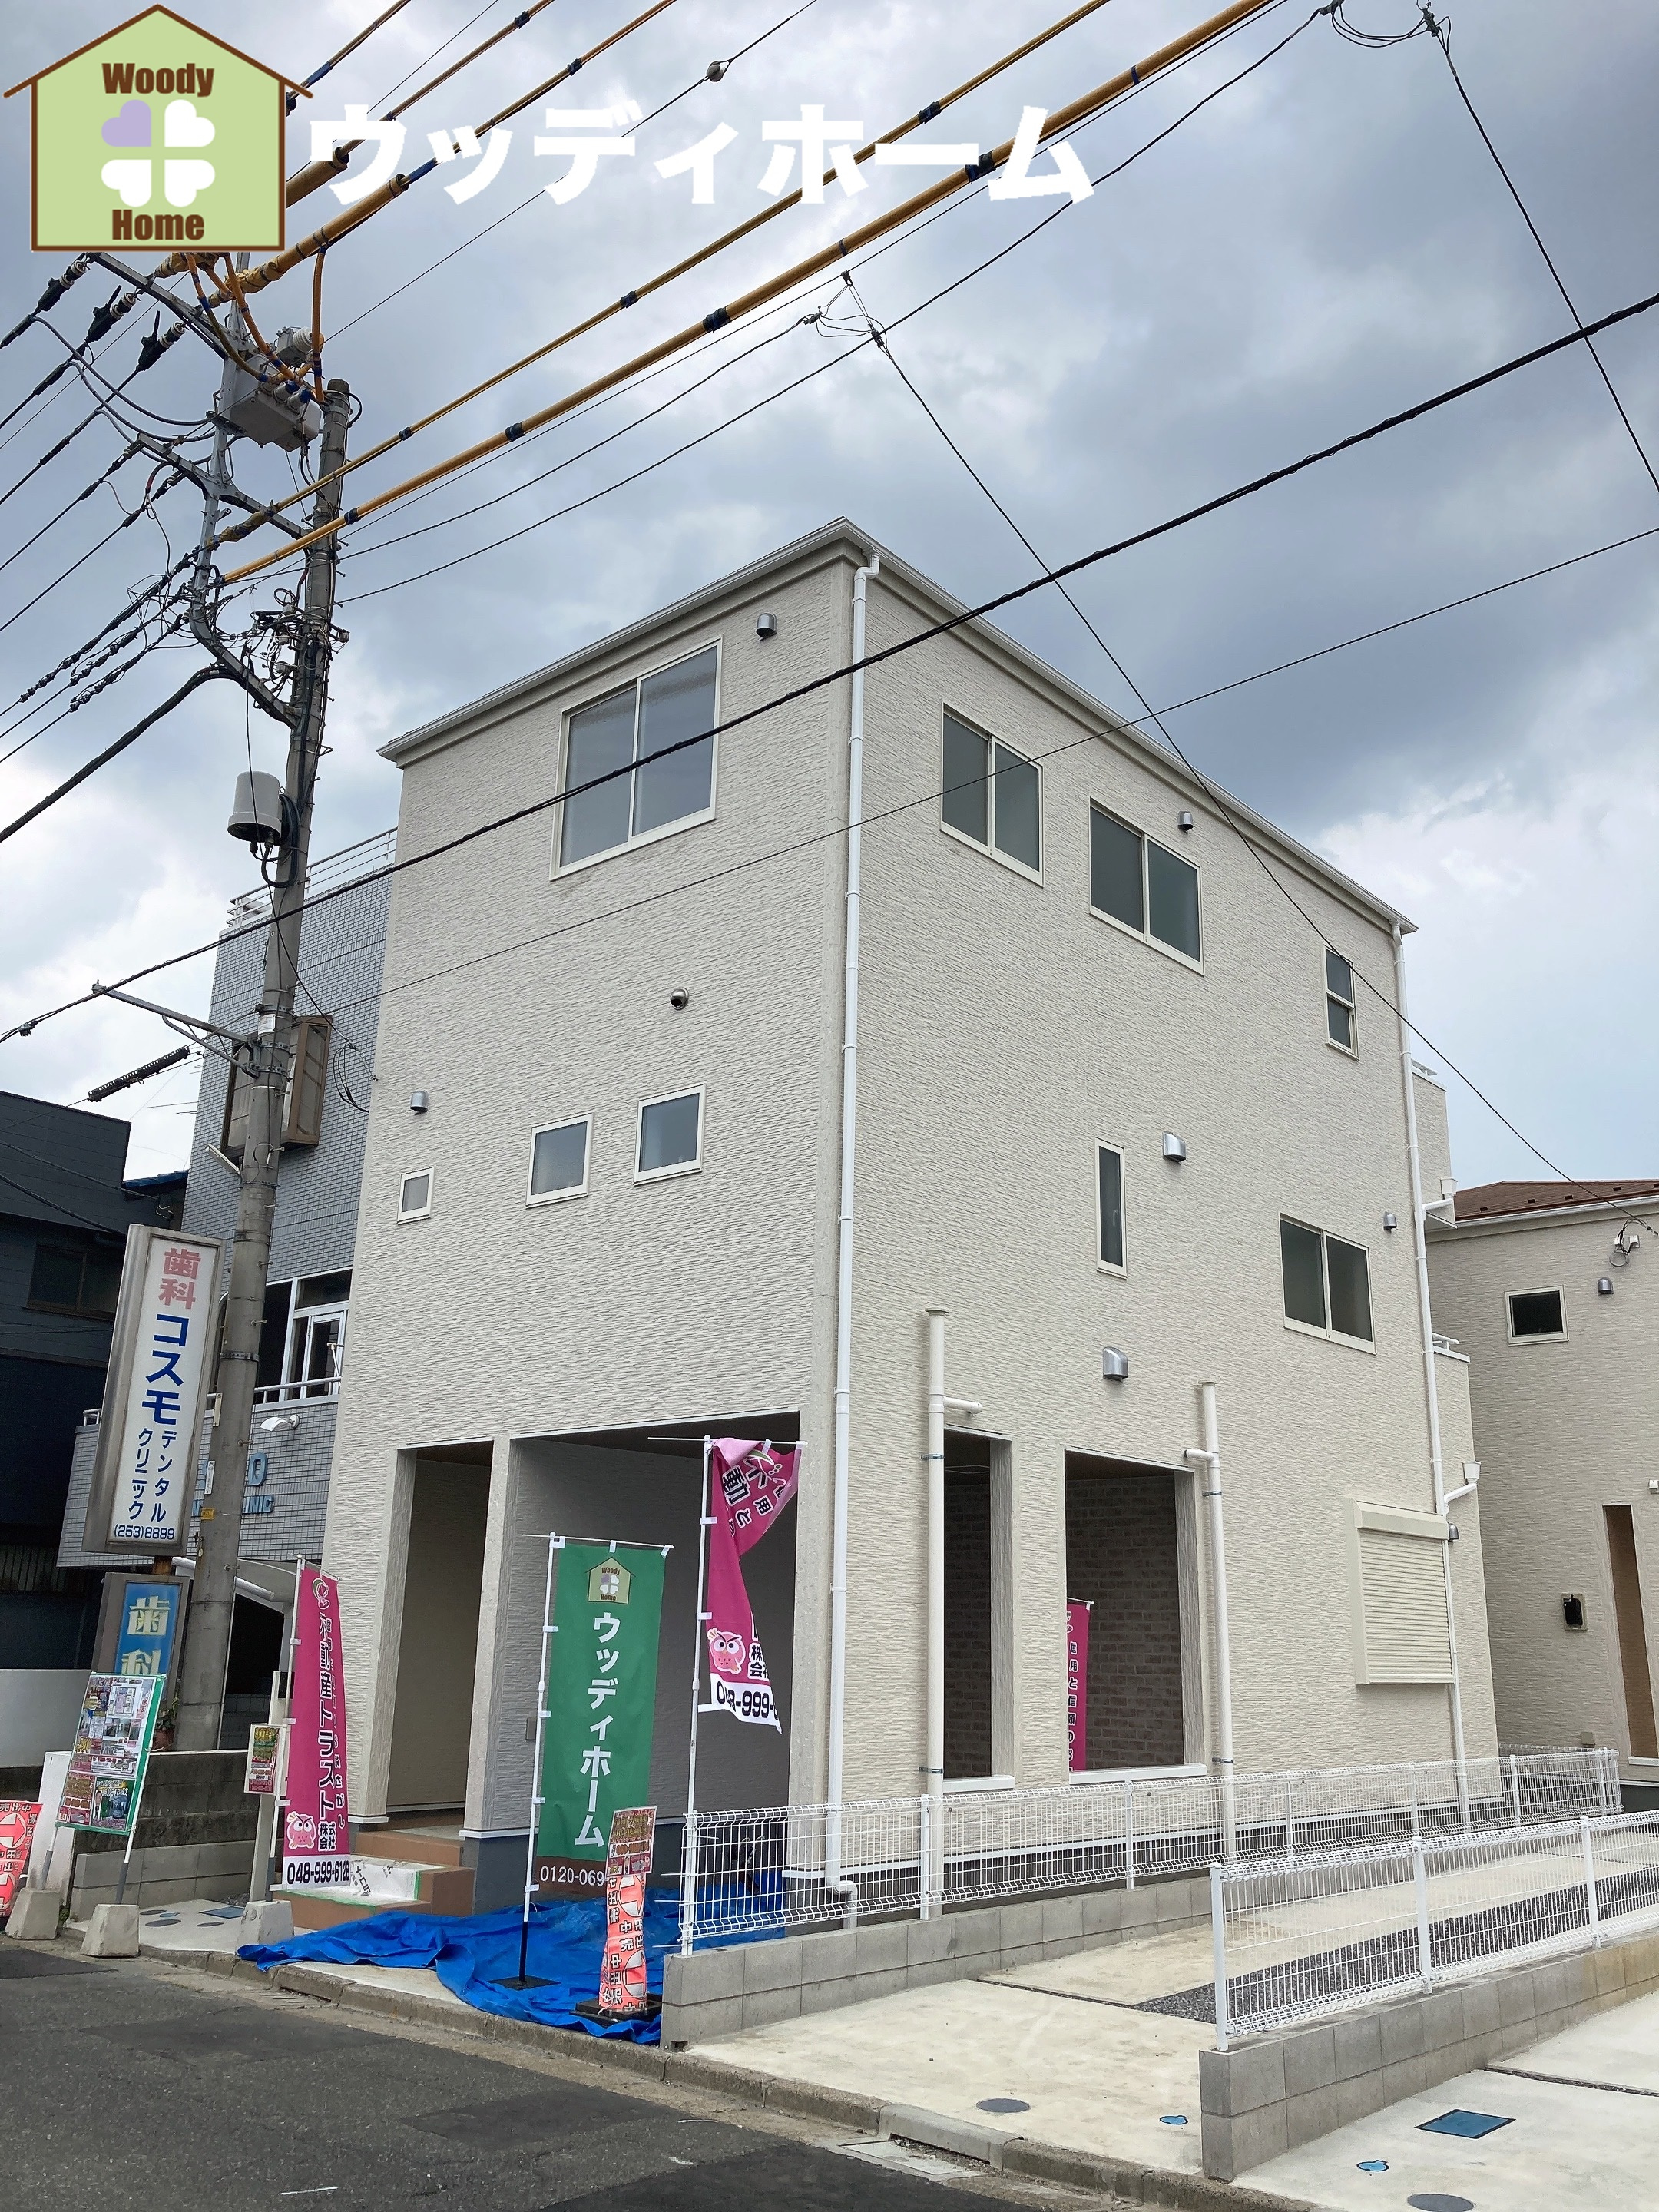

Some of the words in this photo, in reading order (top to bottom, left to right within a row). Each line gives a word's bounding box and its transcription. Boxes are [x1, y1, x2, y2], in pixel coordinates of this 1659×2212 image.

[158, 1248, 201, 1310] 歯科
[141, 1313, 190, 1426] コスモ
[128, 1428, 153, 1521] クリニック
[151, 1431, 177, 1522] デンタル
[114, 1524, 175, 1540] (253)8899
[601, 1567, 620, 1575] Woody
[575, 1611, 621, 1847] ウッディホーム
[286, 1859, 350, 1885] 048-999-6128
[540, 1866, 604, 1887] 0120-069
